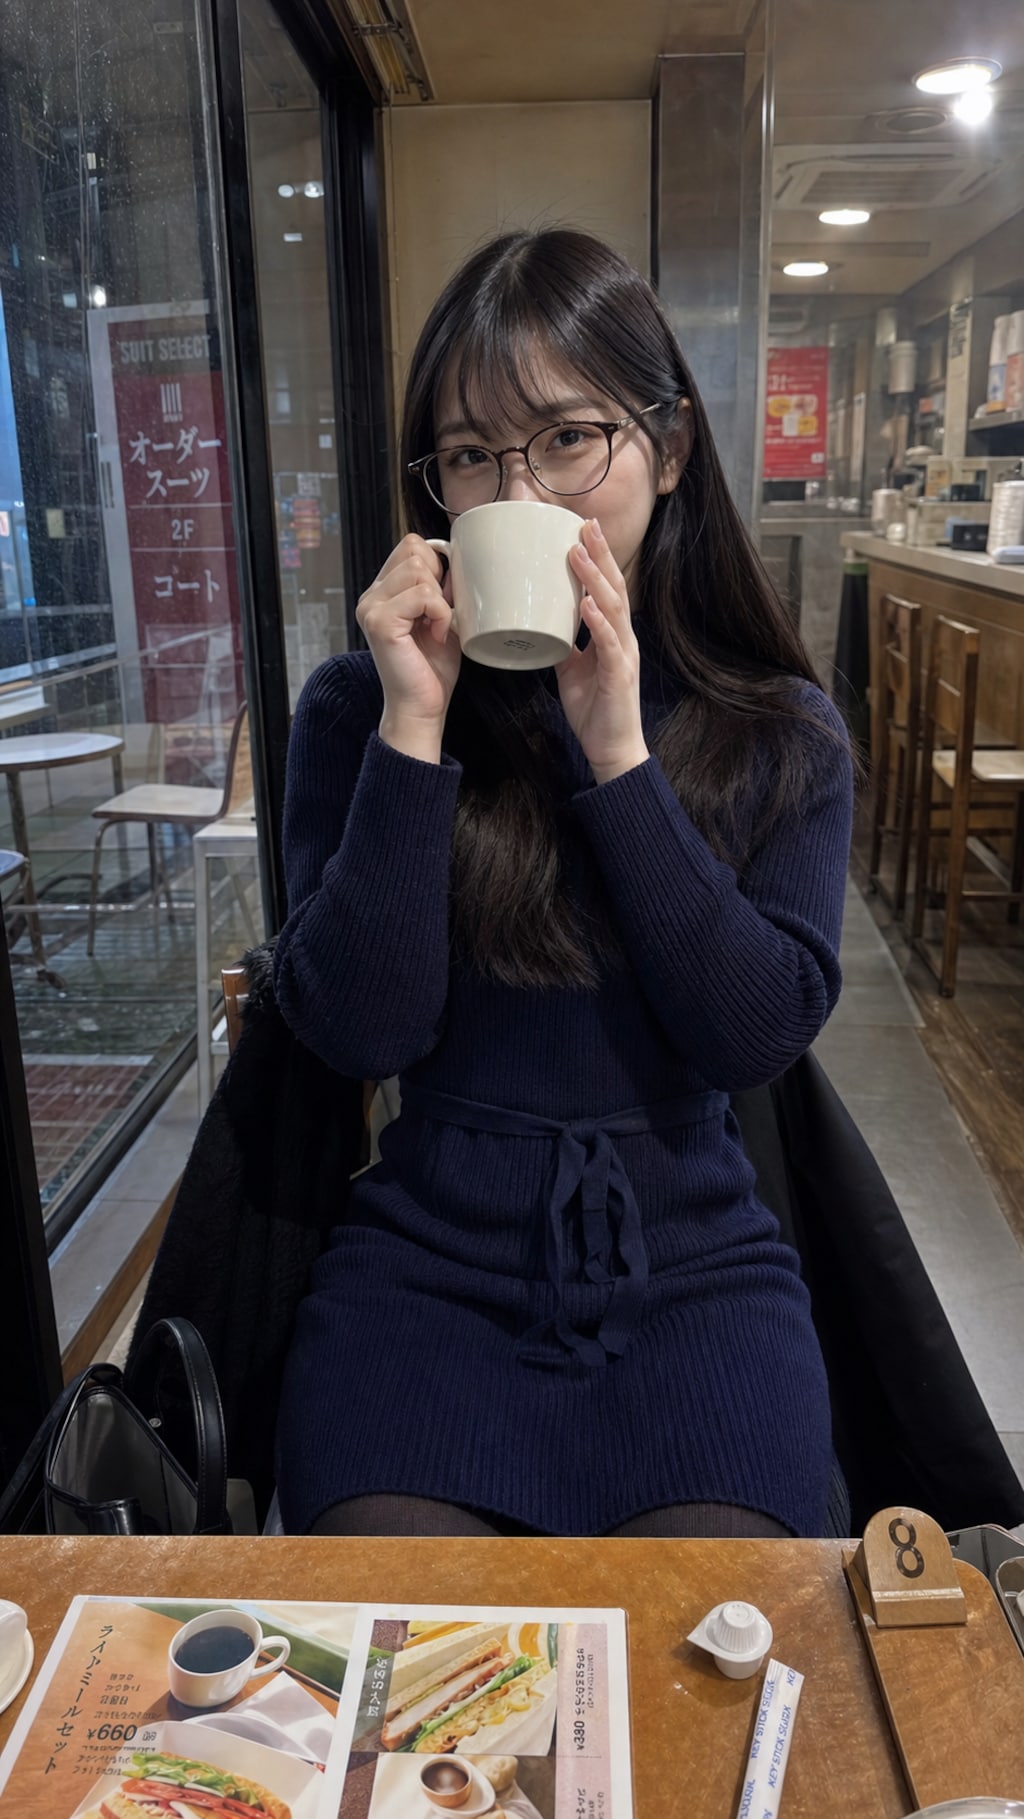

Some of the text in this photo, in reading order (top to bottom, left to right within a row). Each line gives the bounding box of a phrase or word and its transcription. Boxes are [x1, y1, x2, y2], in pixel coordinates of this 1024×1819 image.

[120, 335, 211, 364] SUIT SELECT
[128, 425, 222, 466] オーダー
[146, 467, 210, 499] スーツ
[171, 519, 195, 541] 2F
[154, 569, 220, 603] コート
[888, 1517, 925, 1579] 8
[87, 1722, 139, 1742] ¥660
[767, 1763, 780, 1789] KEY
